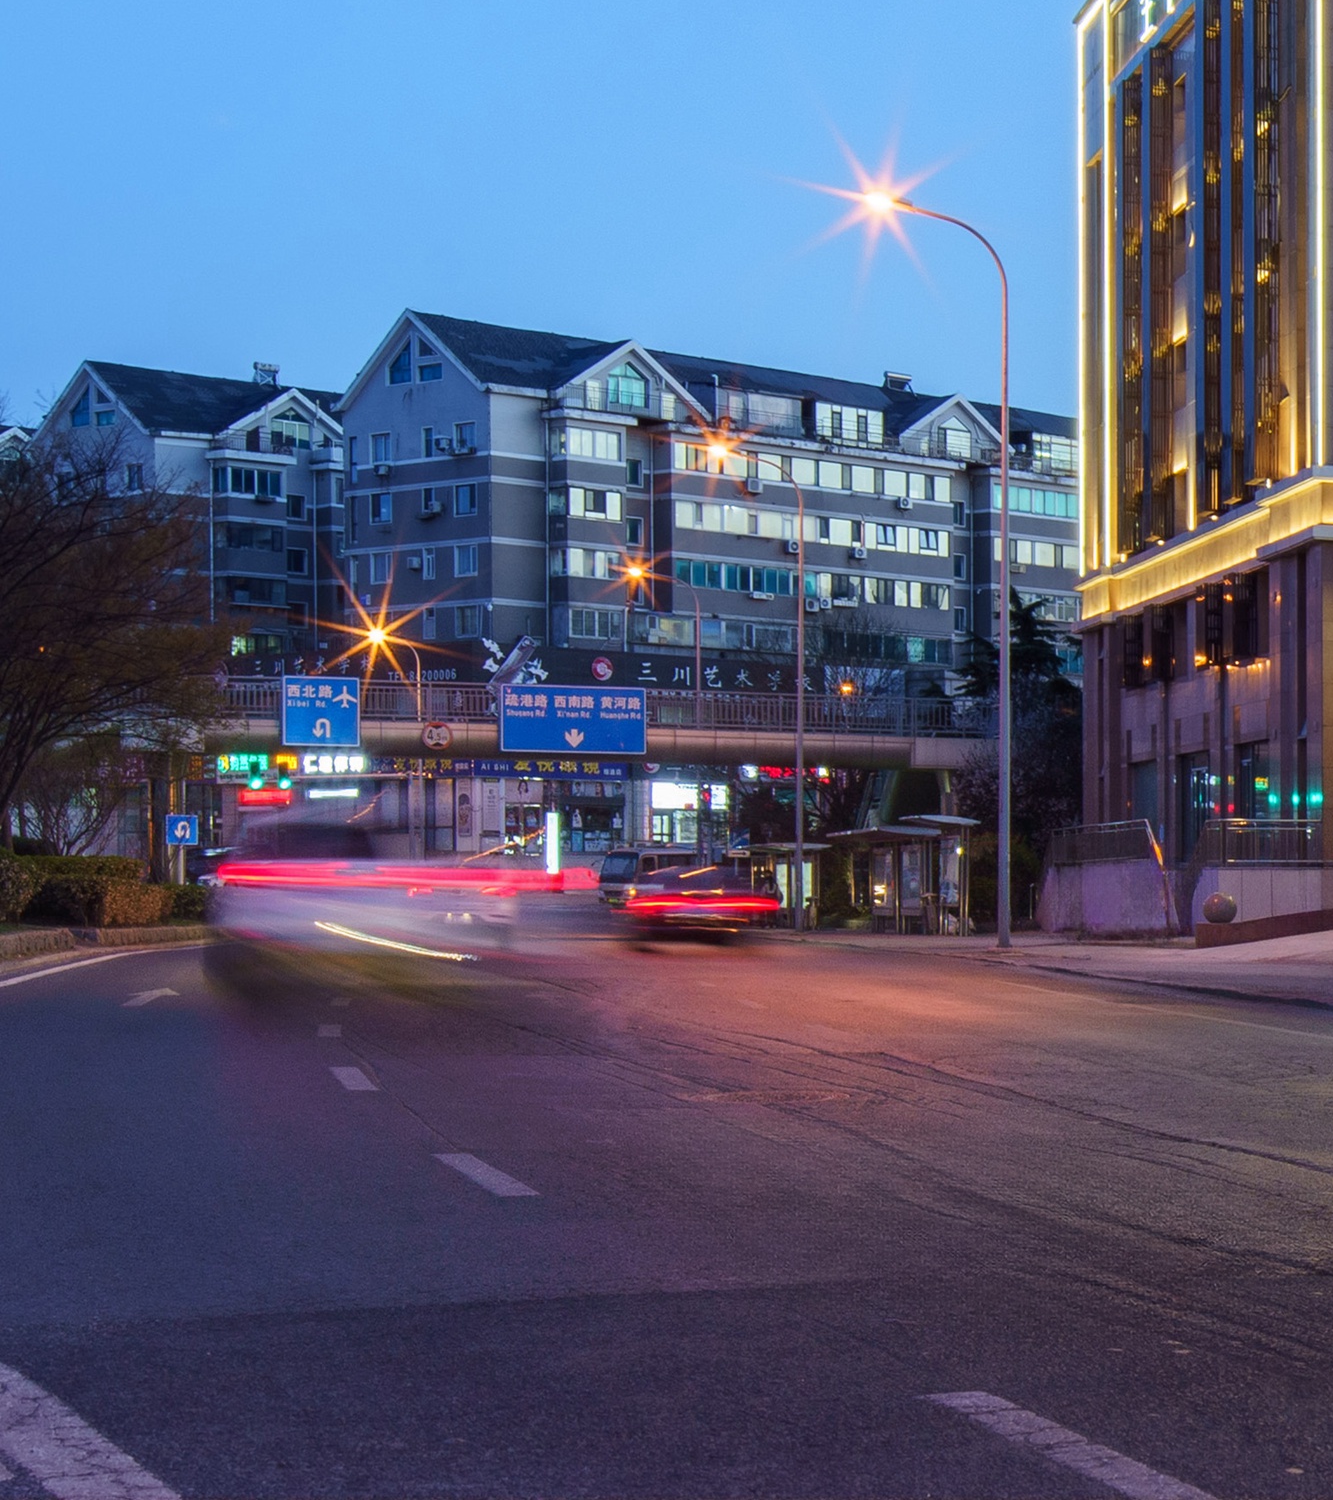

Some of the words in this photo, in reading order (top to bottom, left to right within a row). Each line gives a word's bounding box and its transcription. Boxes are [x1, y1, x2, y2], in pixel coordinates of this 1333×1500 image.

[287, 684, 333, 698] 西北路
[505, 694, 548, 708] 疏港路
[554, 695, 594, 709] 西南路
[601, 696, 641, 710] 黄河路
